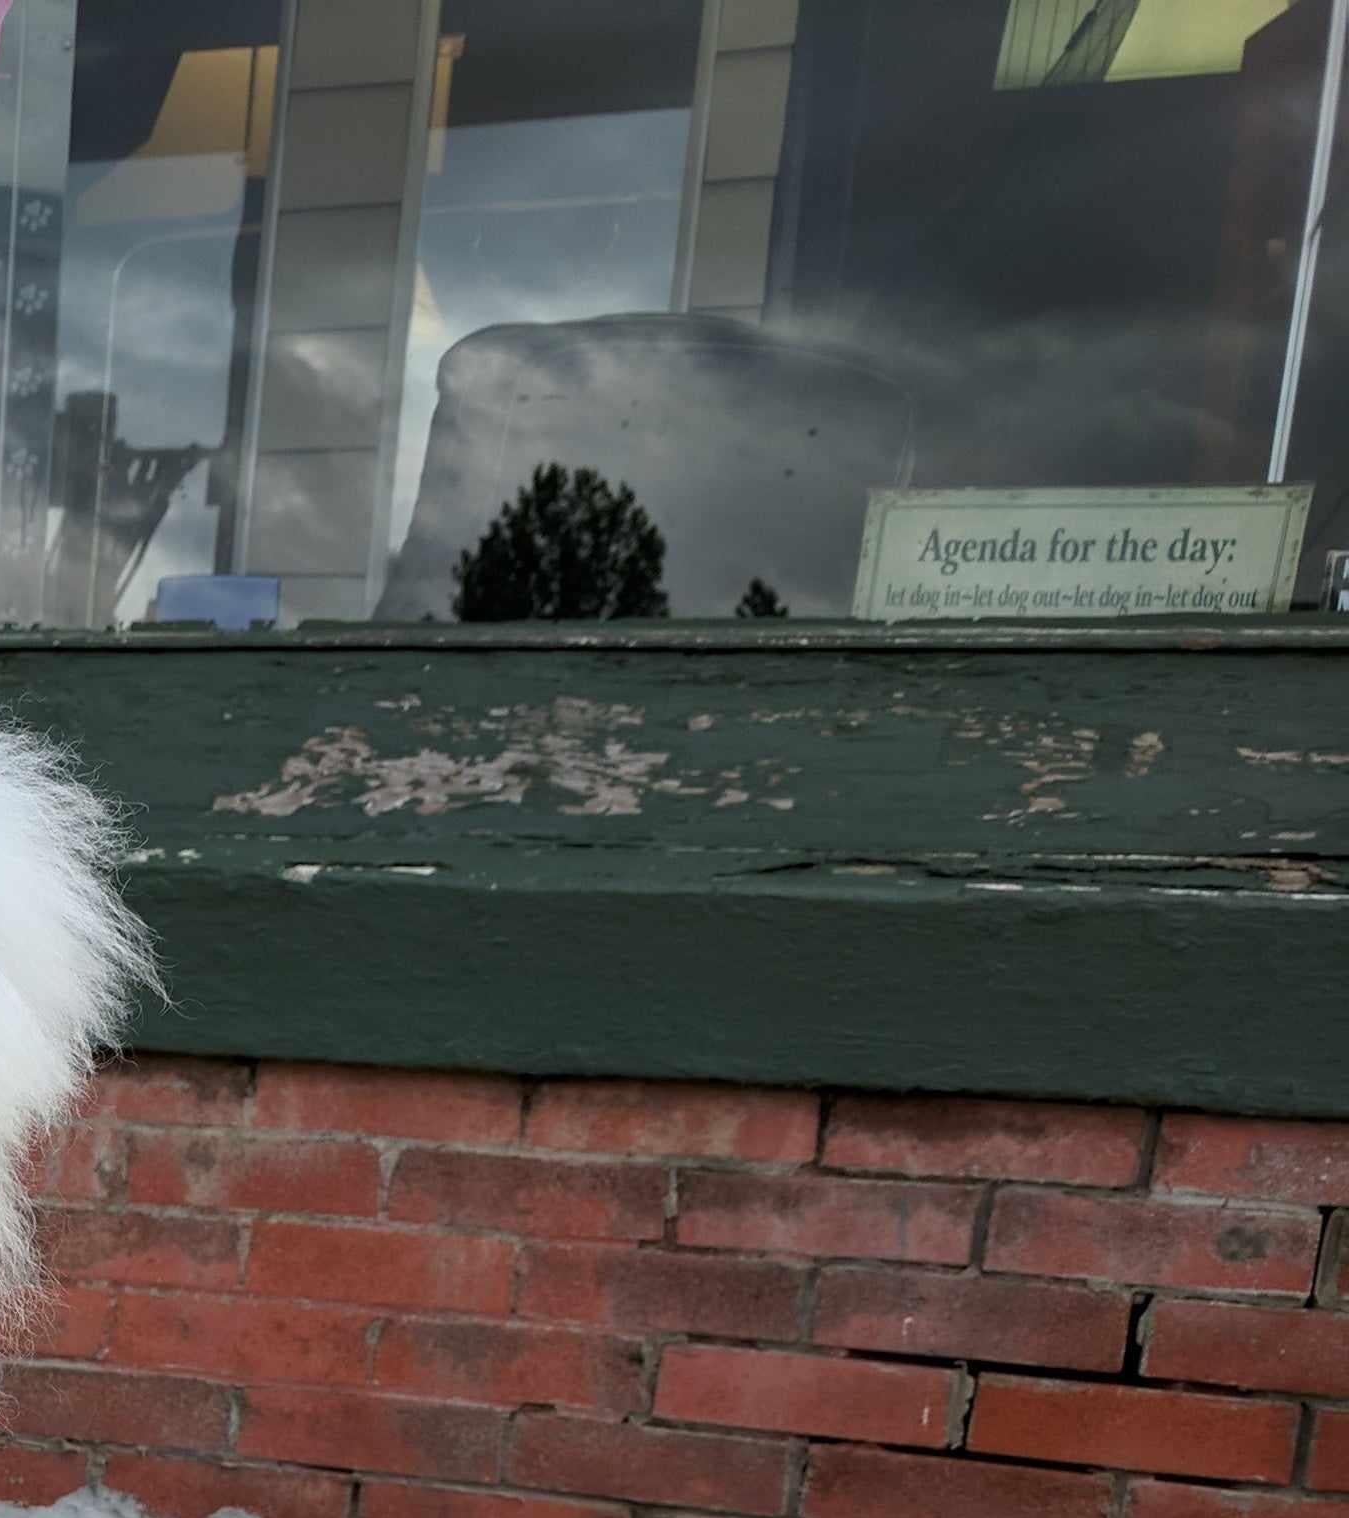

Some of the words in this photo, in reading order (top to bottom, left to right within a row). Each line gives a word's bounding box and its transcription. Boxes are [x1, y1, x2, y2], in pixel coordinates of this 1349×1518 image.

[917, 527, 1037, 576] Agenda
[1047, 527, 1097, 563] for
[1106, 527, 1158, 563] the
[1167, 527, 1237, 576] day:
[885, 583, 906, 607] let
[910, 583, 941, 614] dog
[998, 584, 1029, 615] dog
[1099, 584, 1131, 616] dog
[1192, 584, 1224, 613] dog
[1228, 588, 1258, 608] out
